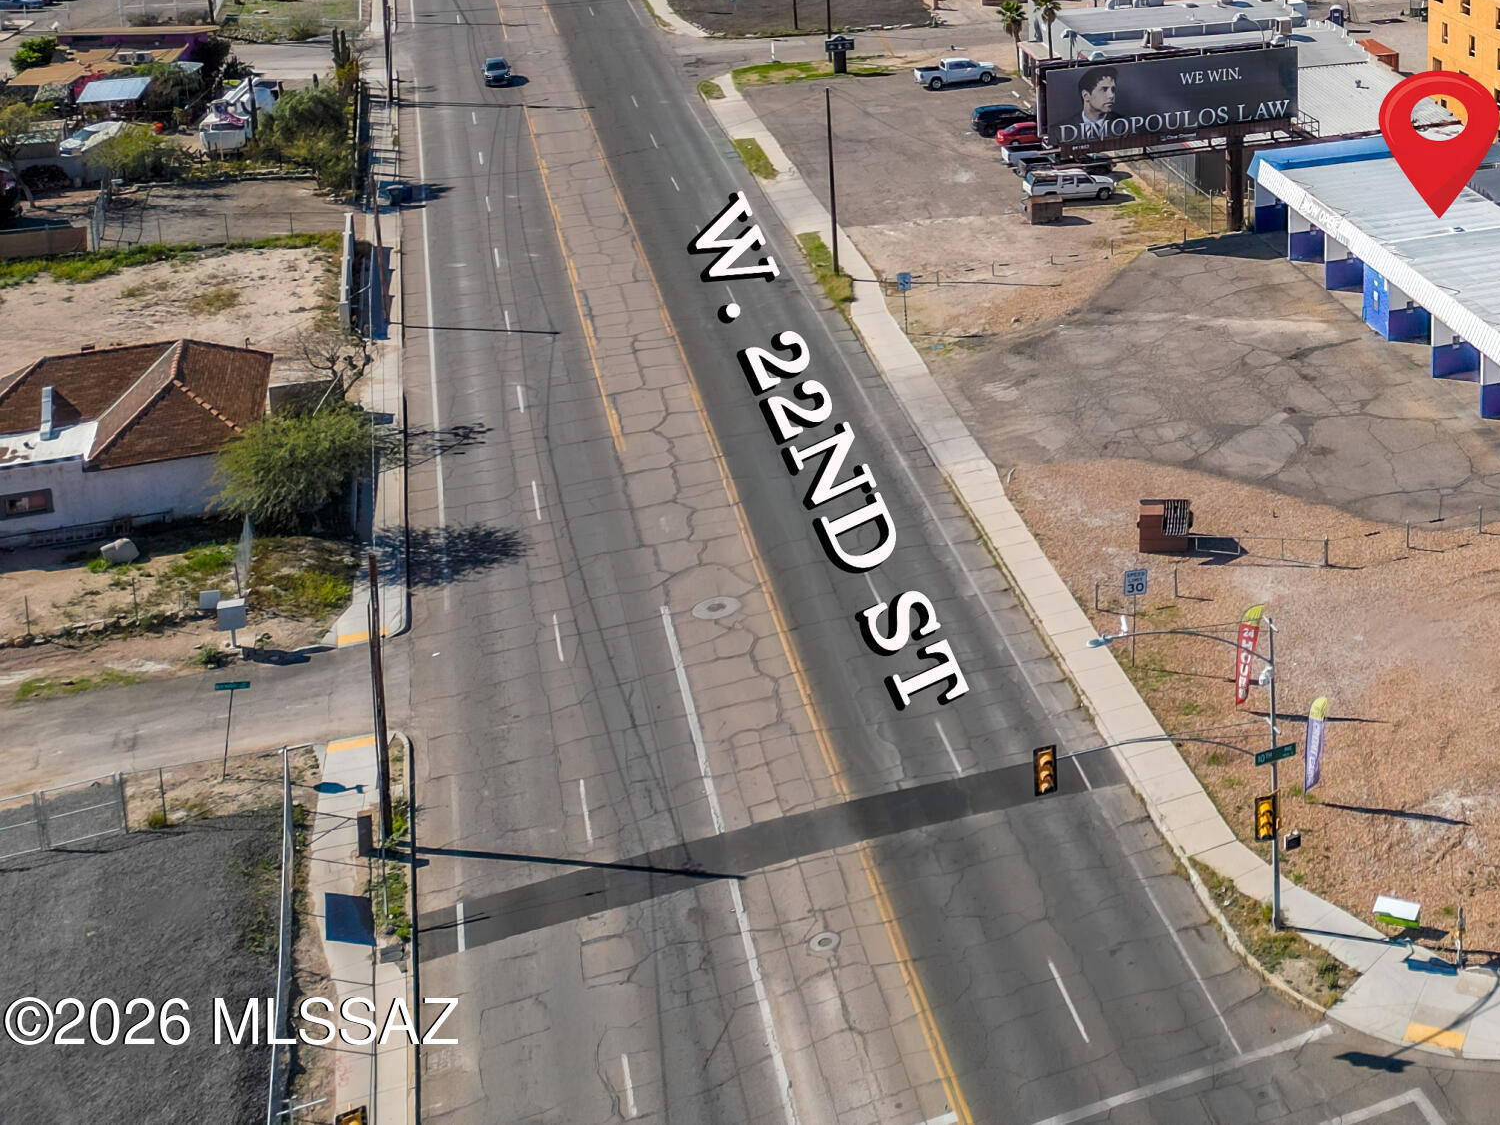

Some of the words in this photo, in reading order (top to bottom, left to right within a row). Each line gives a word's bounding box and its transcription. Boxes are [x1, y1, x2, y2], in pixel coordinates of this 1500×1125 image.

[1179, 70, 1204, 85] WE
[1207, 66, 1242, 83] WIN.
[1058, 106, 1229, 143] DIMOPOULOS
[1237, 99, 1290, 122] LAW
[1127, 582, 1145, 594] 30
[1243, 627, 1255, 639] 24
